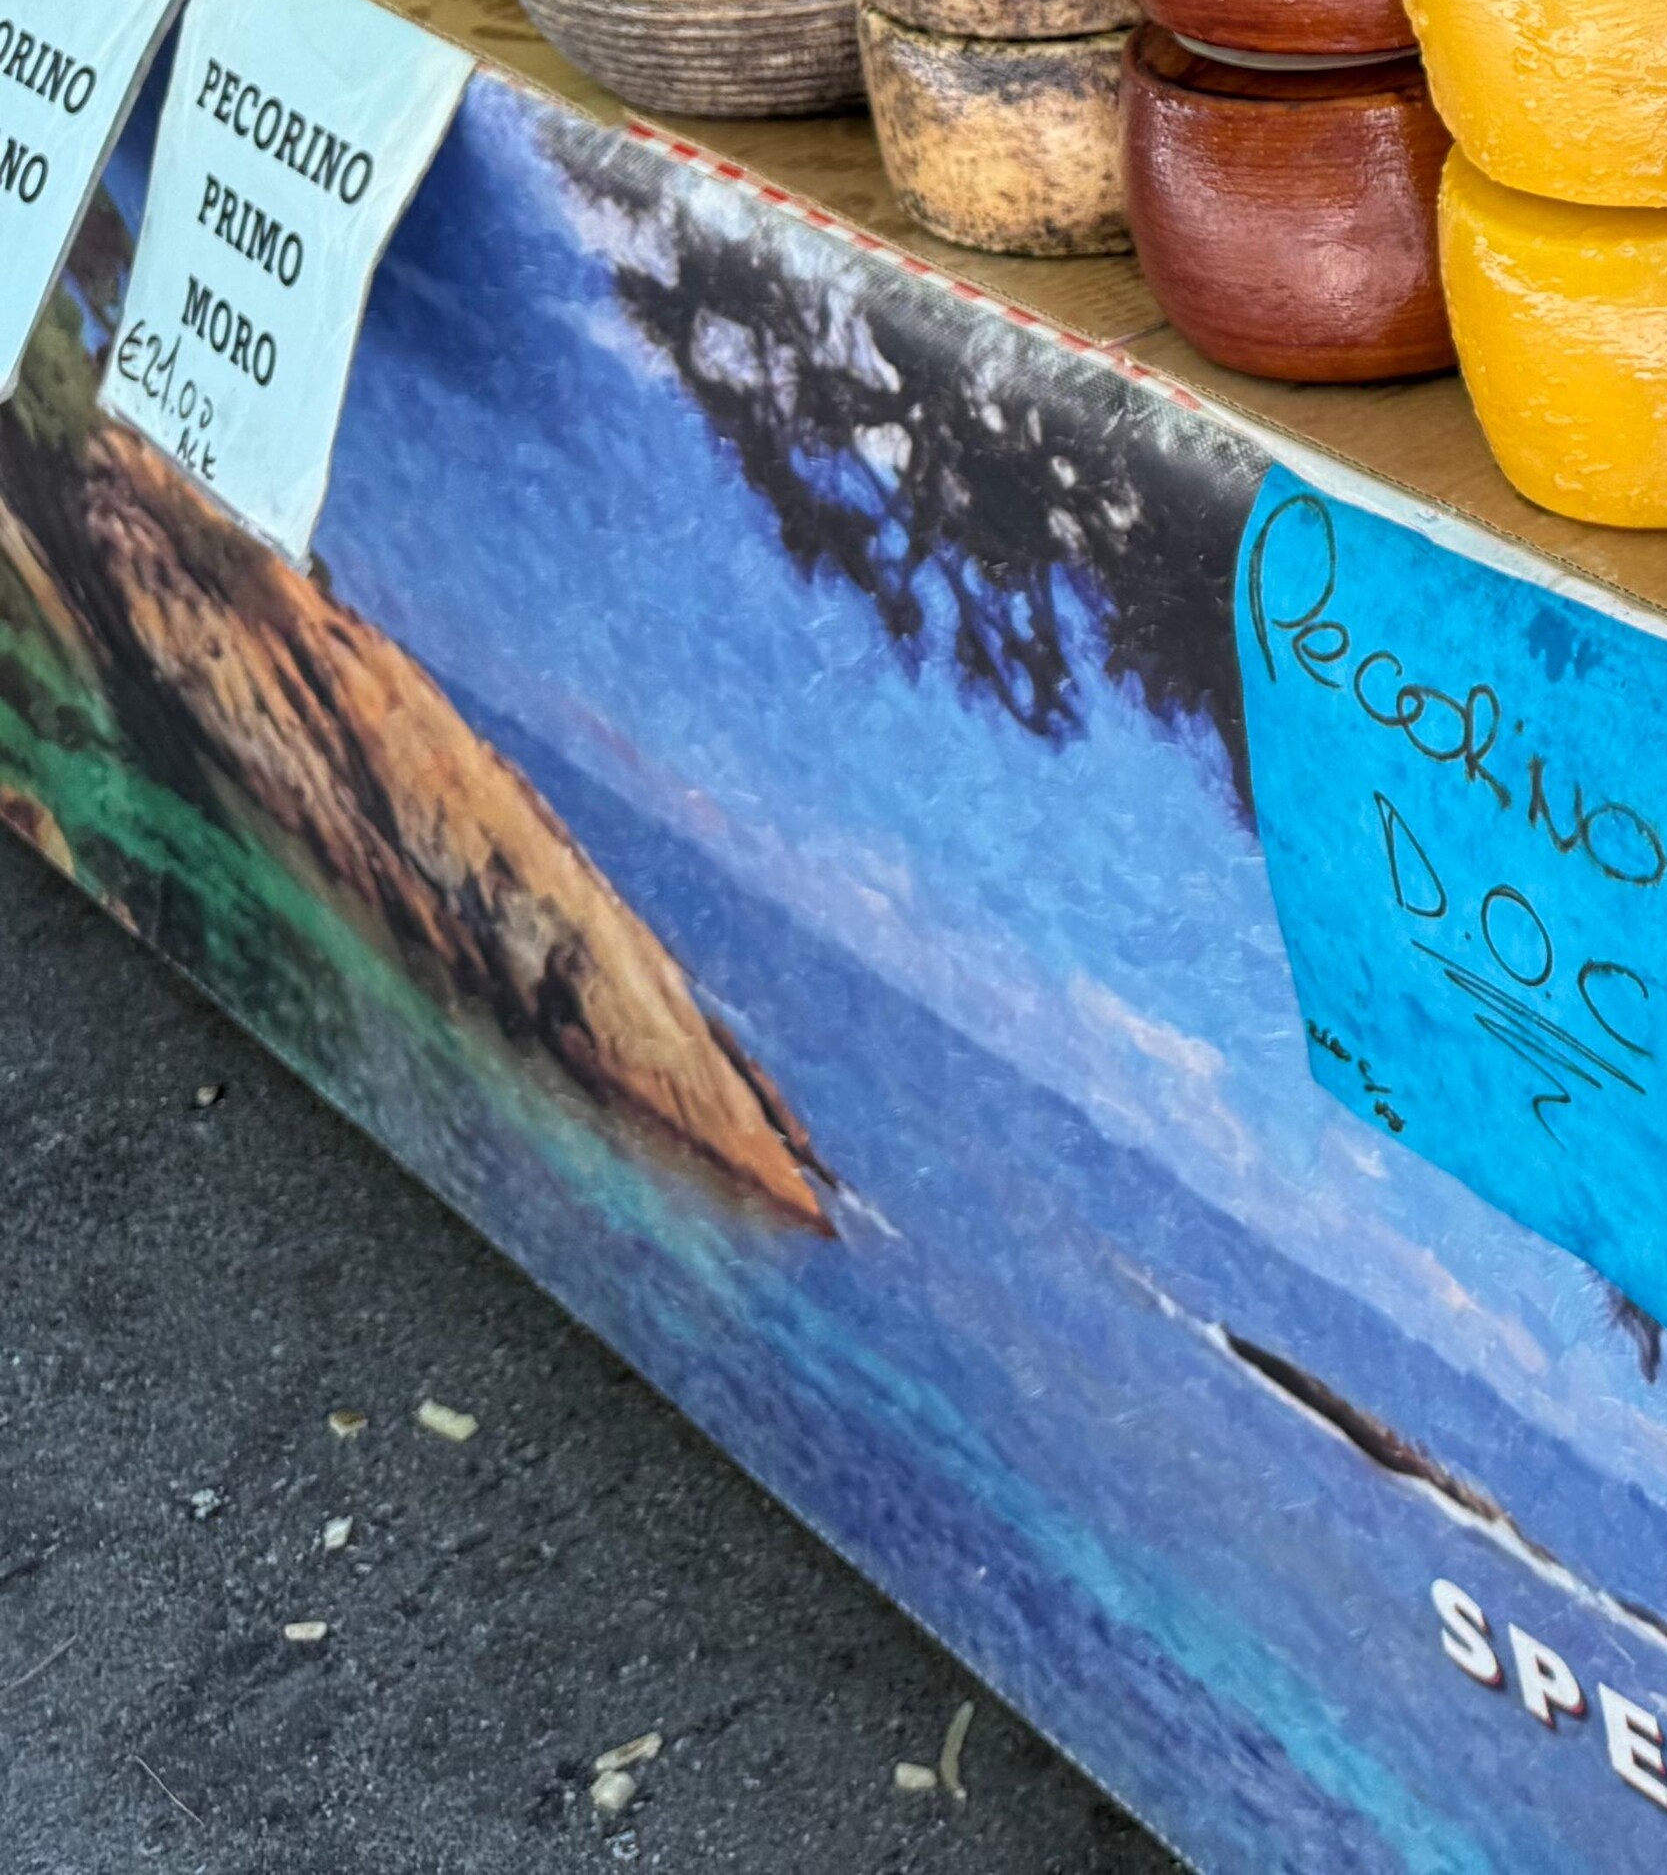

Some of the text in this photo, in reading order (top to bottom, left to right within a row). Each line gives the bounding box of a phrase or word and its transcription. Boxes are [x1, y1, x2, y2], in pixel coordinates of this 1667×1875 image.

[197, 57, 375, 205] PECORINO
[198, 174, 304, 288] PRIMO
[181, 274, 278, 389] MORO
